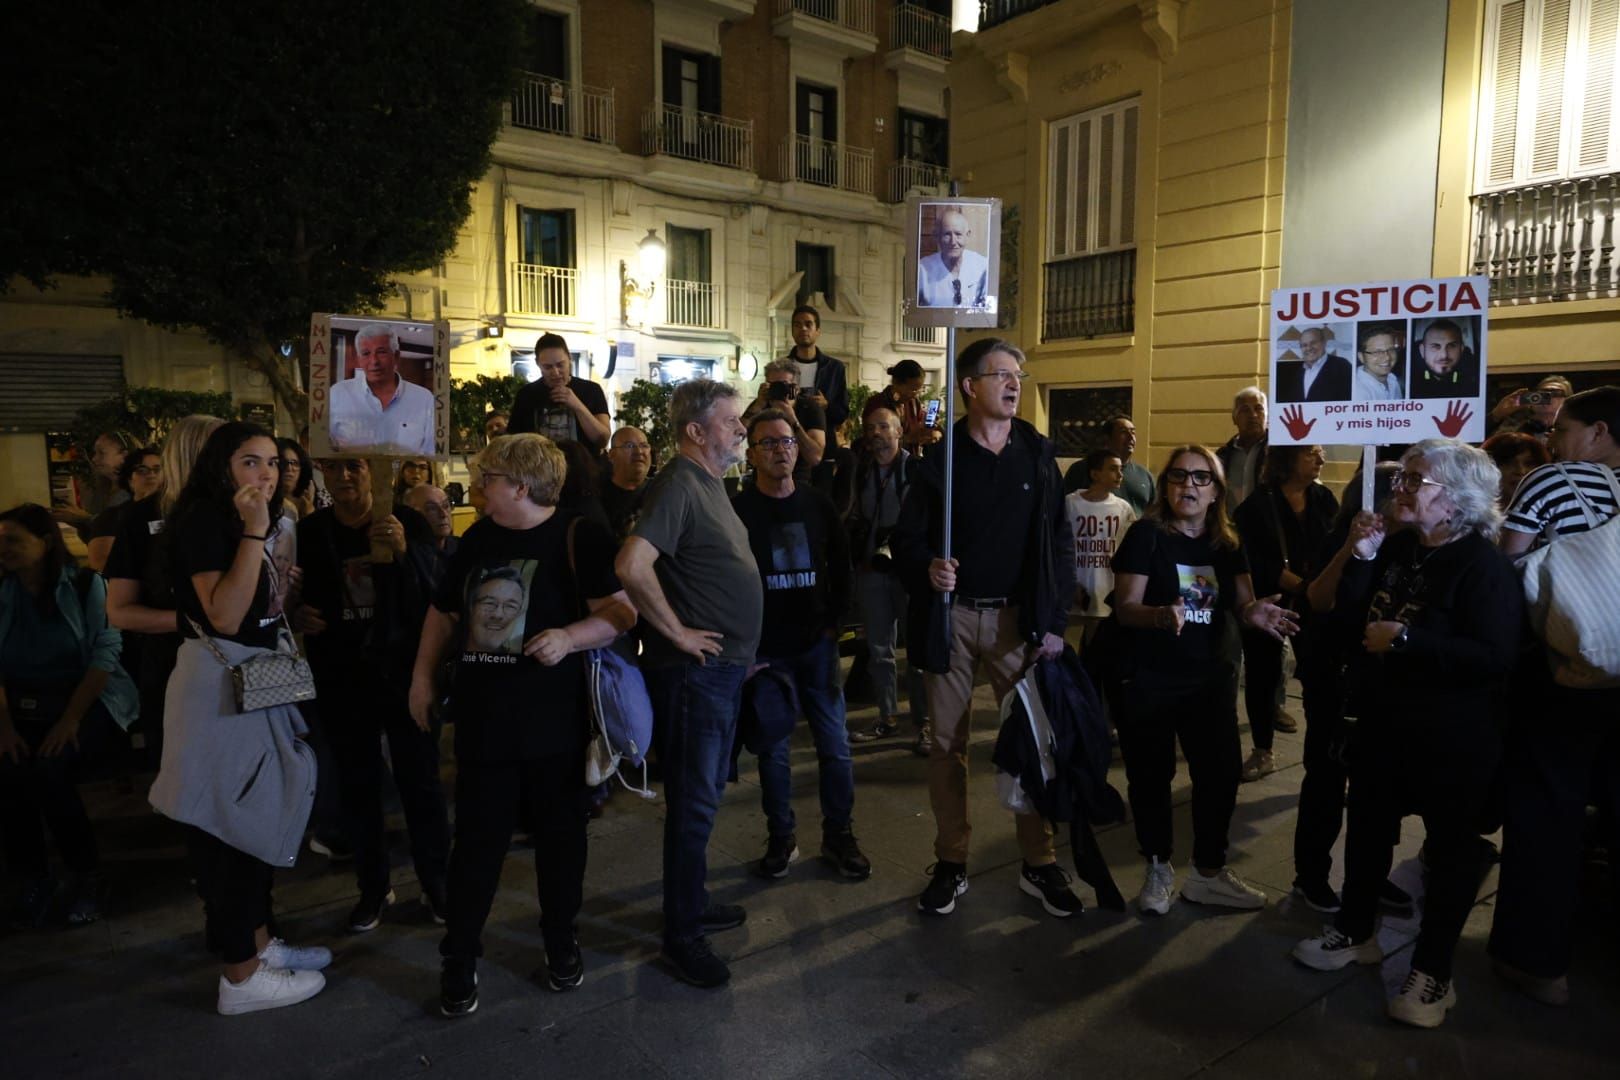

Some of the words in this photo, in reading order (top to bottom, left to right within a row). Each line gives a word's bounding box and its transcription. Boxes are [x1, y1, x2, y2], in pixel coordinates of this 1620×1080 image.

[1277, 282, 1482, 321] JUSTICIA
[312, 324, 326, 424] MAZÓN
[1325, 404, 1348, 416] por
[1352, 402, 1369, 412] mi
[1374, 400, 1424, 412] marido
[1336, 419, 1344, 431] y
[1348, 418, 1373, 429] mis
[1377, 417, 1411, 430] hijos
[1076, 515, 1120, 537] 20:11
[1077, 540, 1087, 553] NI
[1077, 555, 1086, 568] NI
[478, 652, 518, 664] Vicente
